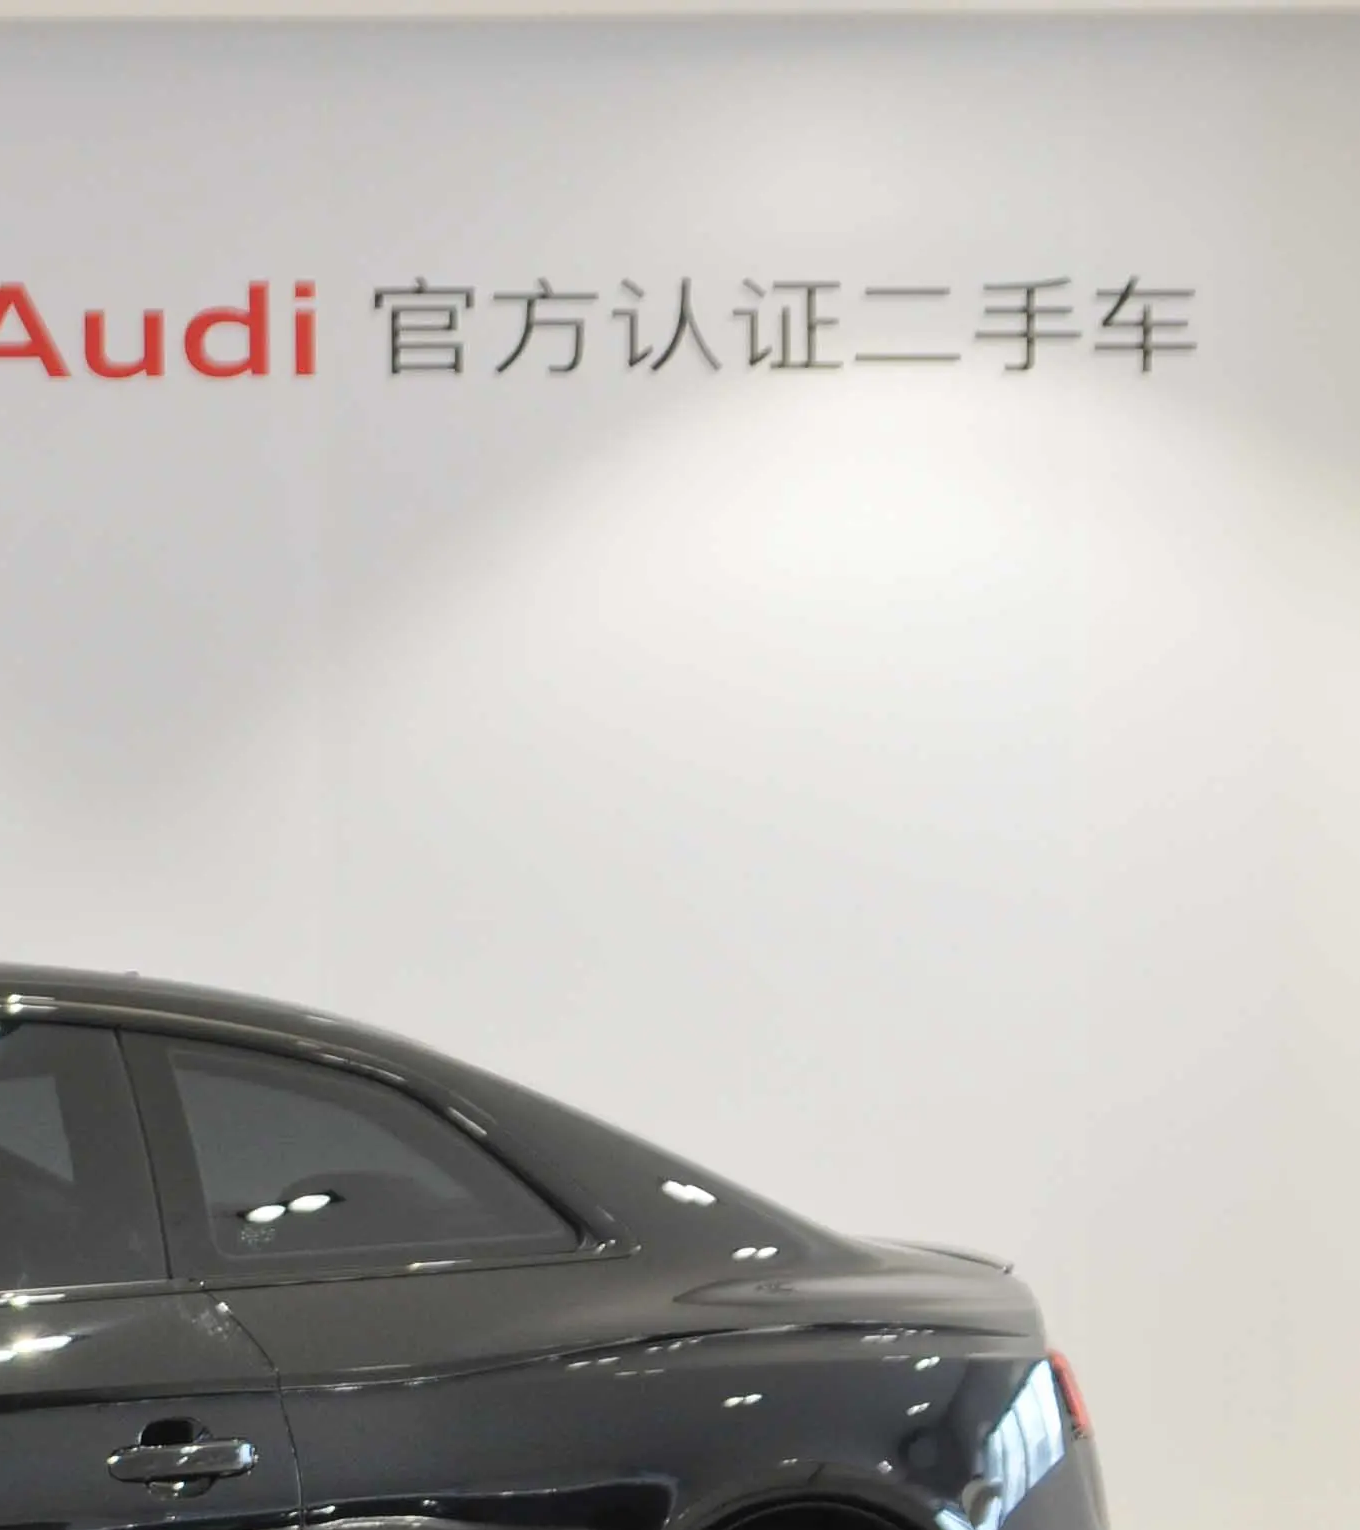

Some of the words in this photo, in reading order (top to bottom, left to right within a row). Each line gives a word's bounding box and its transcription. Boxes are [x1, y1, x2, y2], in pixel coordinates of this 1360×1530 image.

[371, 276, 1198, 376] 官方认证二手车
